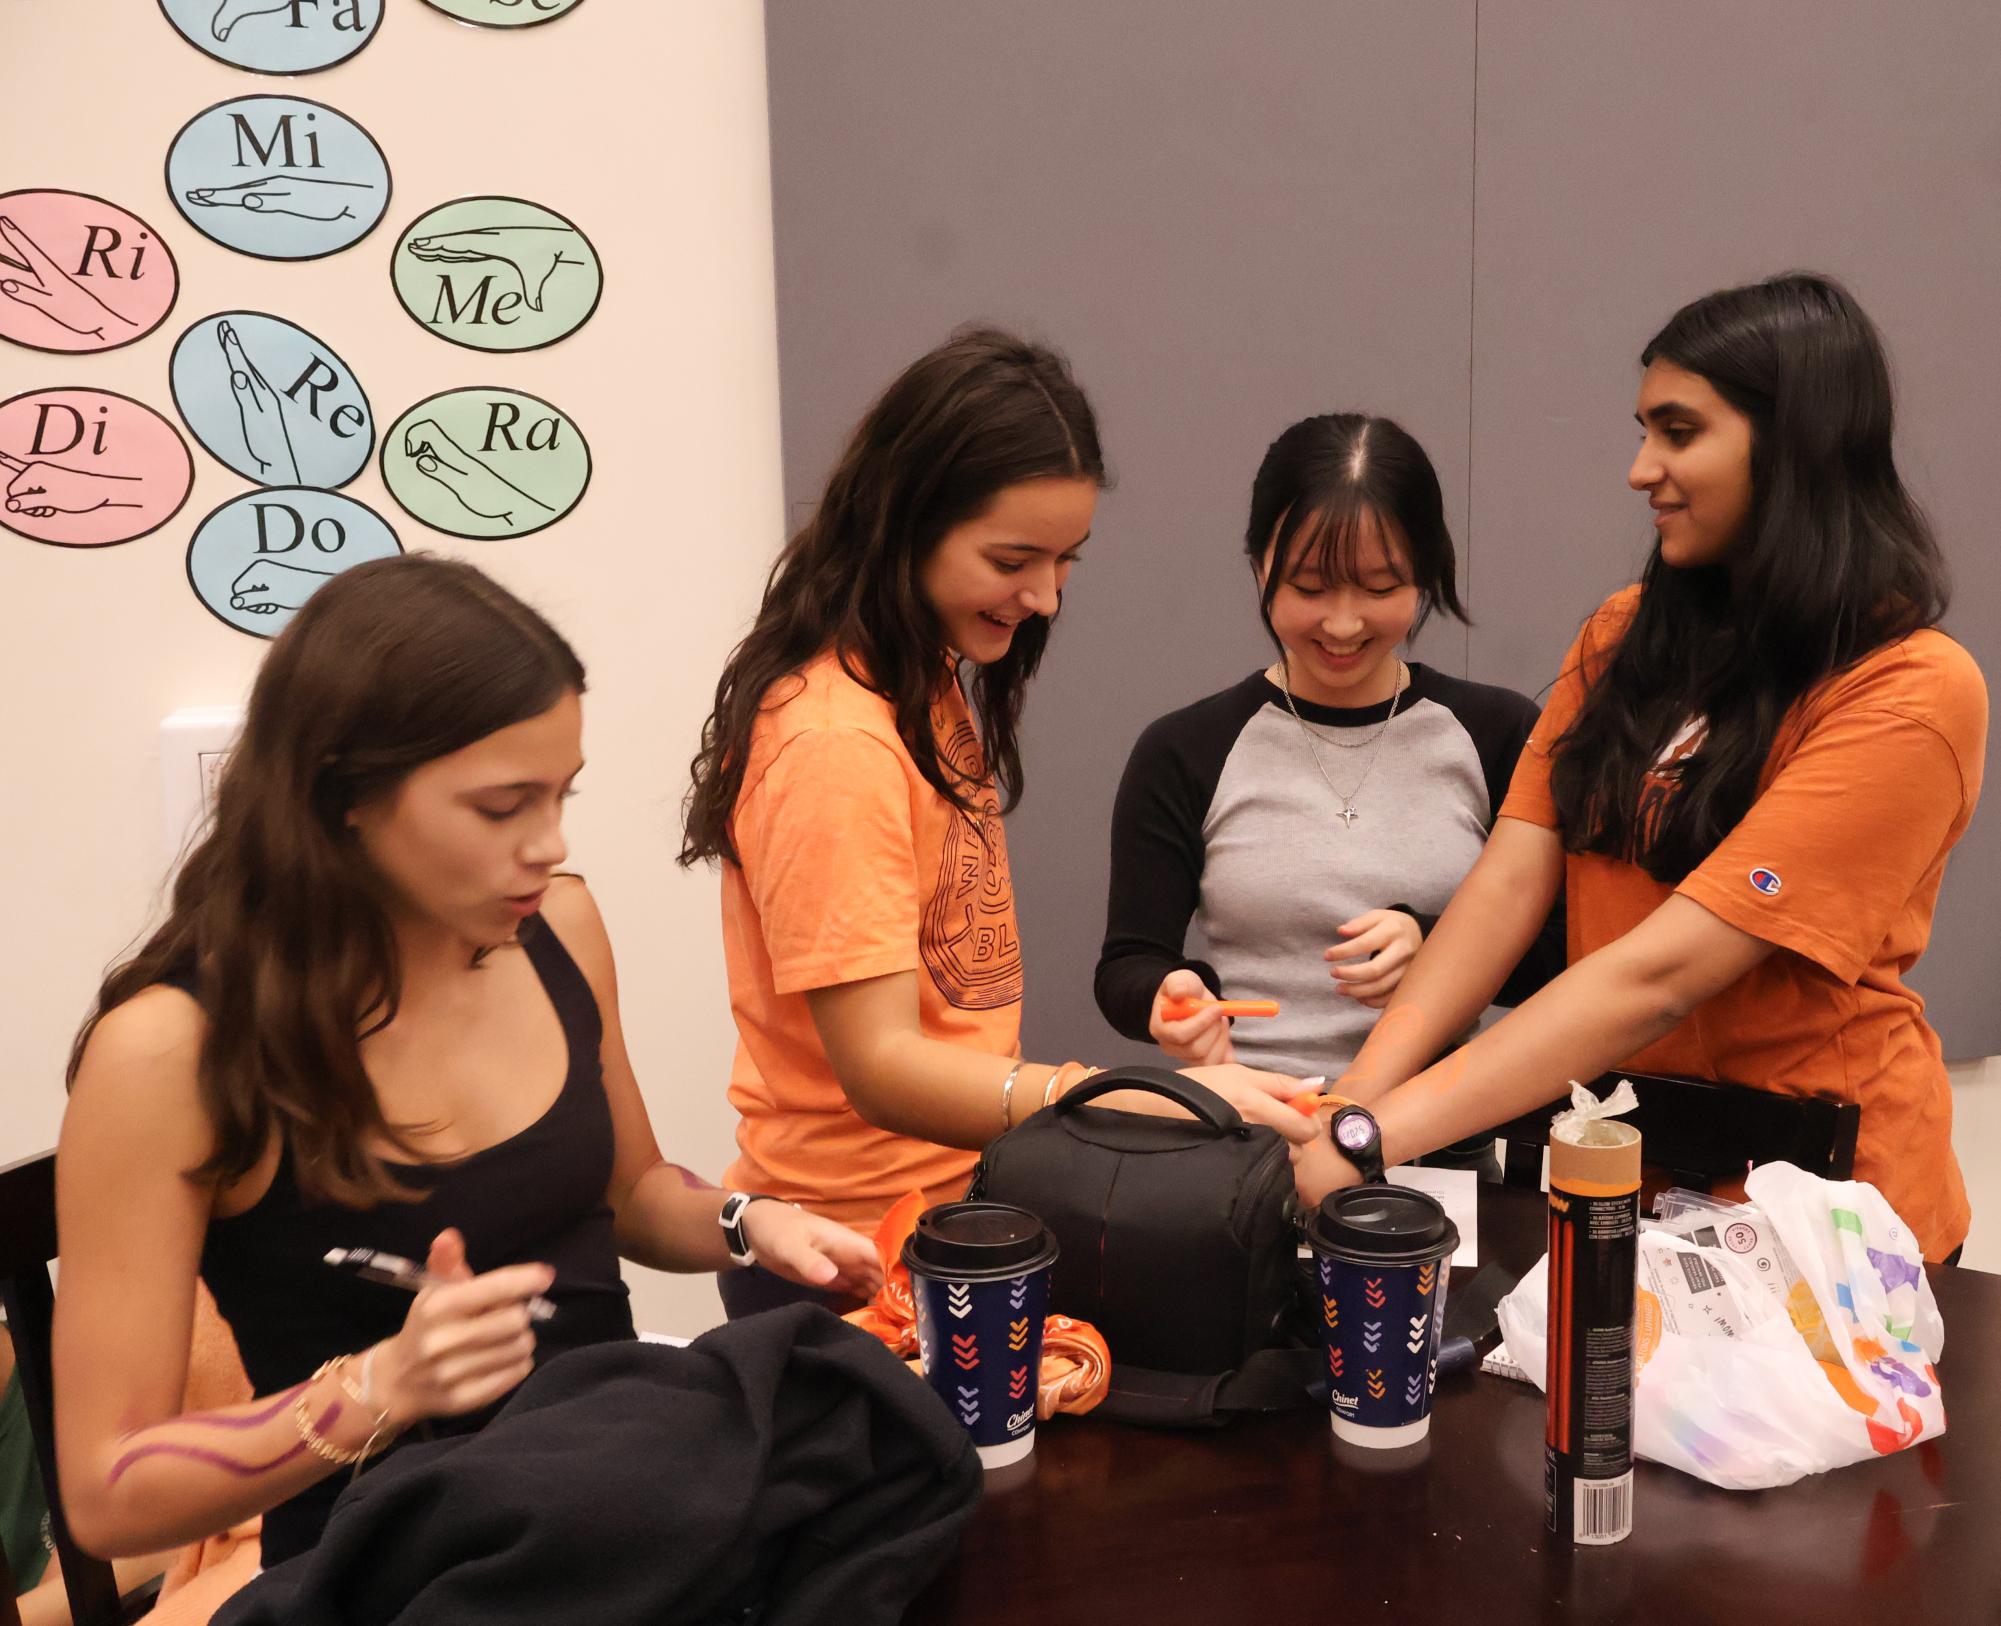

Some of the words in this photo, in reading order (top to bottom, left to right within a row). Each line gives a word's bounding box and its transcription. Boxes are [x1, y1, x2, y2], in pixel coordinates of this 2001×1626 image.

[227, 113, 324, 168] Mi
[71, 224, 148, 281] Ri
[425, 274, 523, 326] Me
[281, 353, 365, 439] Re
[26, 403, 108, 456] Di
[478, 402, 561, 452] Ra
[249, 503, 346, 554] Do
[1735, 1231, 1747, 1245] 50
[1332, 1389, 1359, 1406] Chinet
